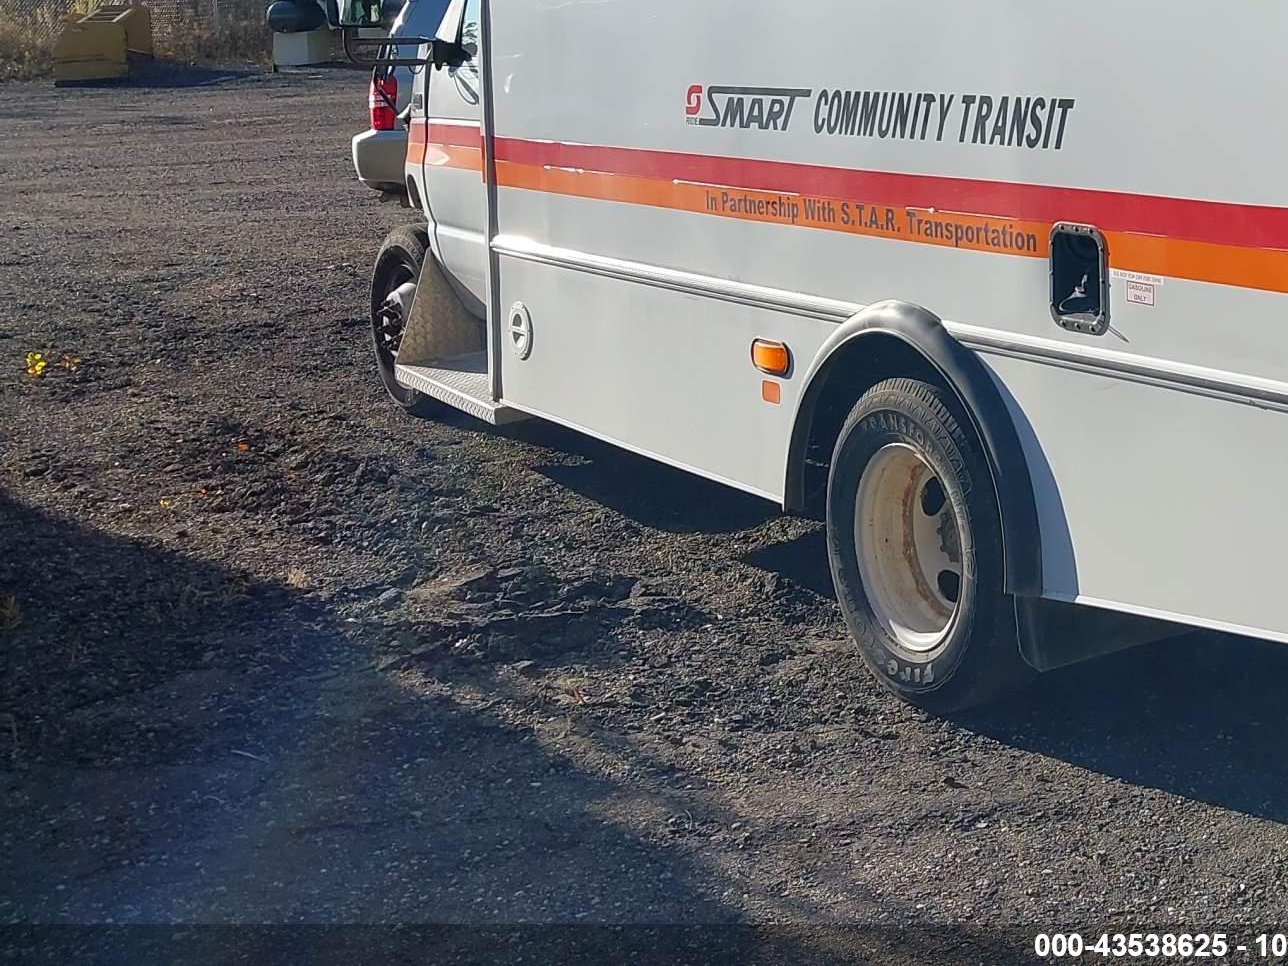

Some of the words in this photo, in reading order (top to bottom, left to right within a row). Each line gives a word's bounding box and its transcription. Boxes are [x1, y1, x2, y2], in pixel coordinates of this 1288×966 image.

[699, 85, 812, 131] SMART
[813, 89, 955, 141] COMMUNITY
[958, 94, 1075, 149] TRANSIT
[706, 190, 718, 211] In
[721, 191, 799, 225] Partnership
[803, 198, 836, 223] With
[841, 202, 901, 233] S.T.A.R.
[906, 208, 1037, 252] Transportation
[1128, 282, 1153, 294] GASOLINE
[1133, 294, 1147, 302] ONLY
